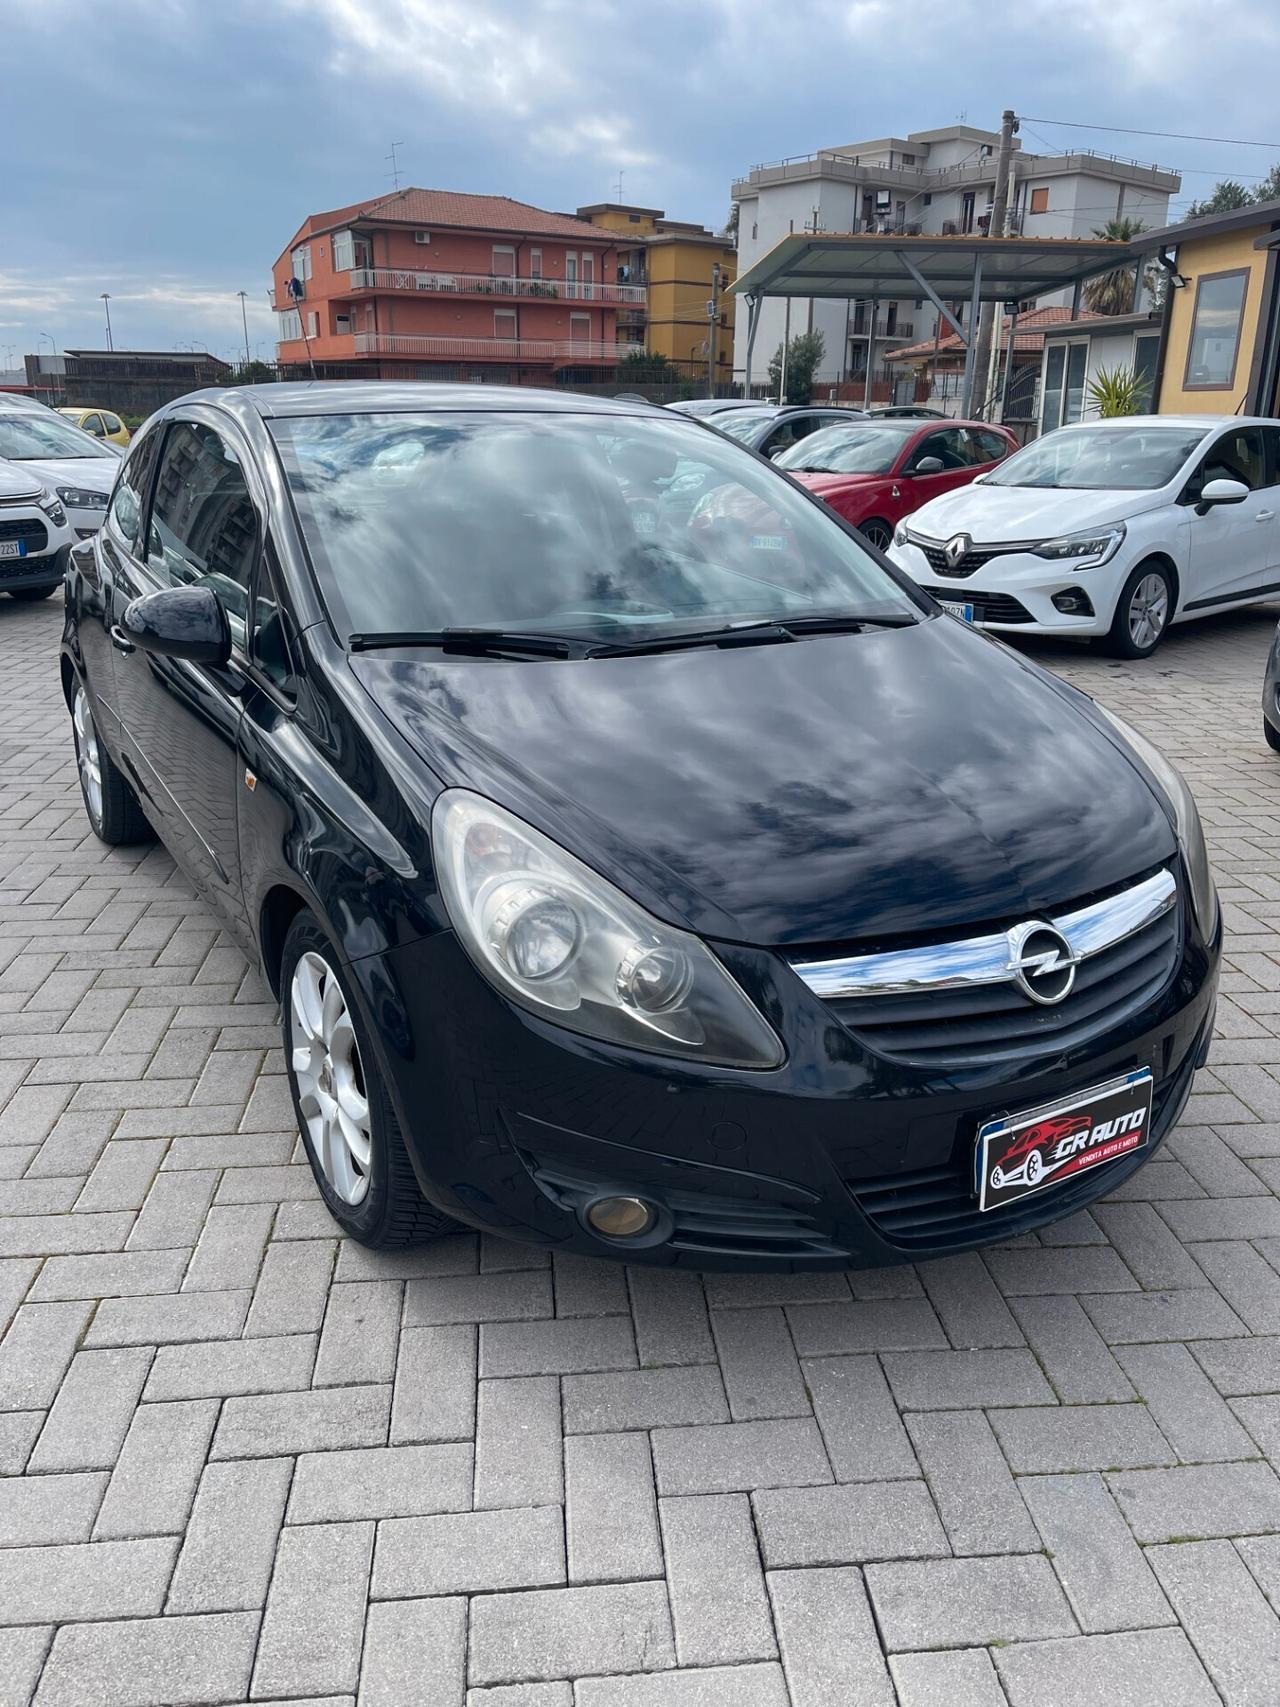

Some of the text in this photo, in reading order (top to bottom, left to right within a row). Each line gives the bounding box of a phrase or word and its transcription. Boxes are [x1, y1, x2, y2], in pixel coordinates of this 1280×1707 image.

[1054, 1107, 1147, 1159] GR AUTO
[1079, 1150, 1102, 1165] VENDITA
[1103, 1144, 1118, 1156] AUTO
[1123, 1136, 1139, 1147] MOTO
